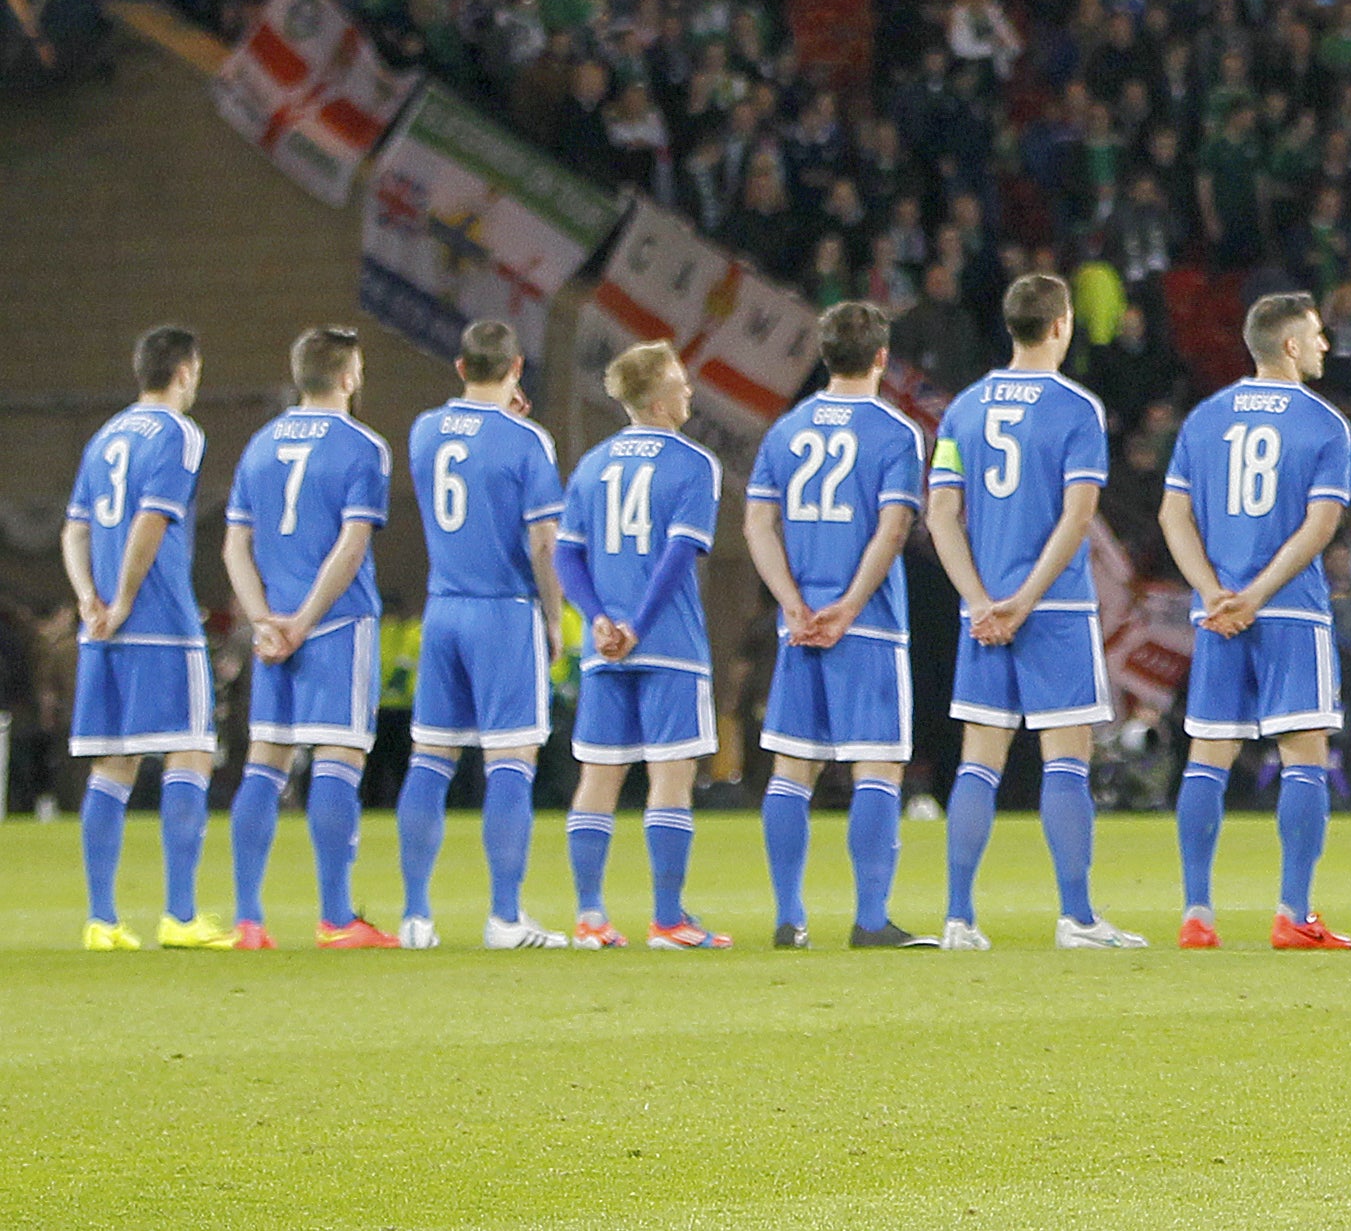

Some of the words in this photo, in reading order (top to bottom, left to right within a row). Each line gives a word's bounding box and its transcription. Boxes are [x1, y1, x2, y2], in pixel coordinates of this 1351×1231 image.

[274, 419, 330, 440] DALLAS
[441, 414, 483, 436] BAIRD
[812, 405, 854, 425] GRIGG
[994, 384, 1044, 404] EVANS
[1233, 393, 1291, 413] HUGHES
[95, 437, 131, 528] 3
[277, 442, 313, 536] 7
[433, 440, 468, 532] 6
[609, 439, 665, 457] REEVES
[787, 428, 858, 522] 22
[983, 406, 1022, 499] 5
[1223, 423, 1281, 517] 18
[599, 460, 656, 555] 14
